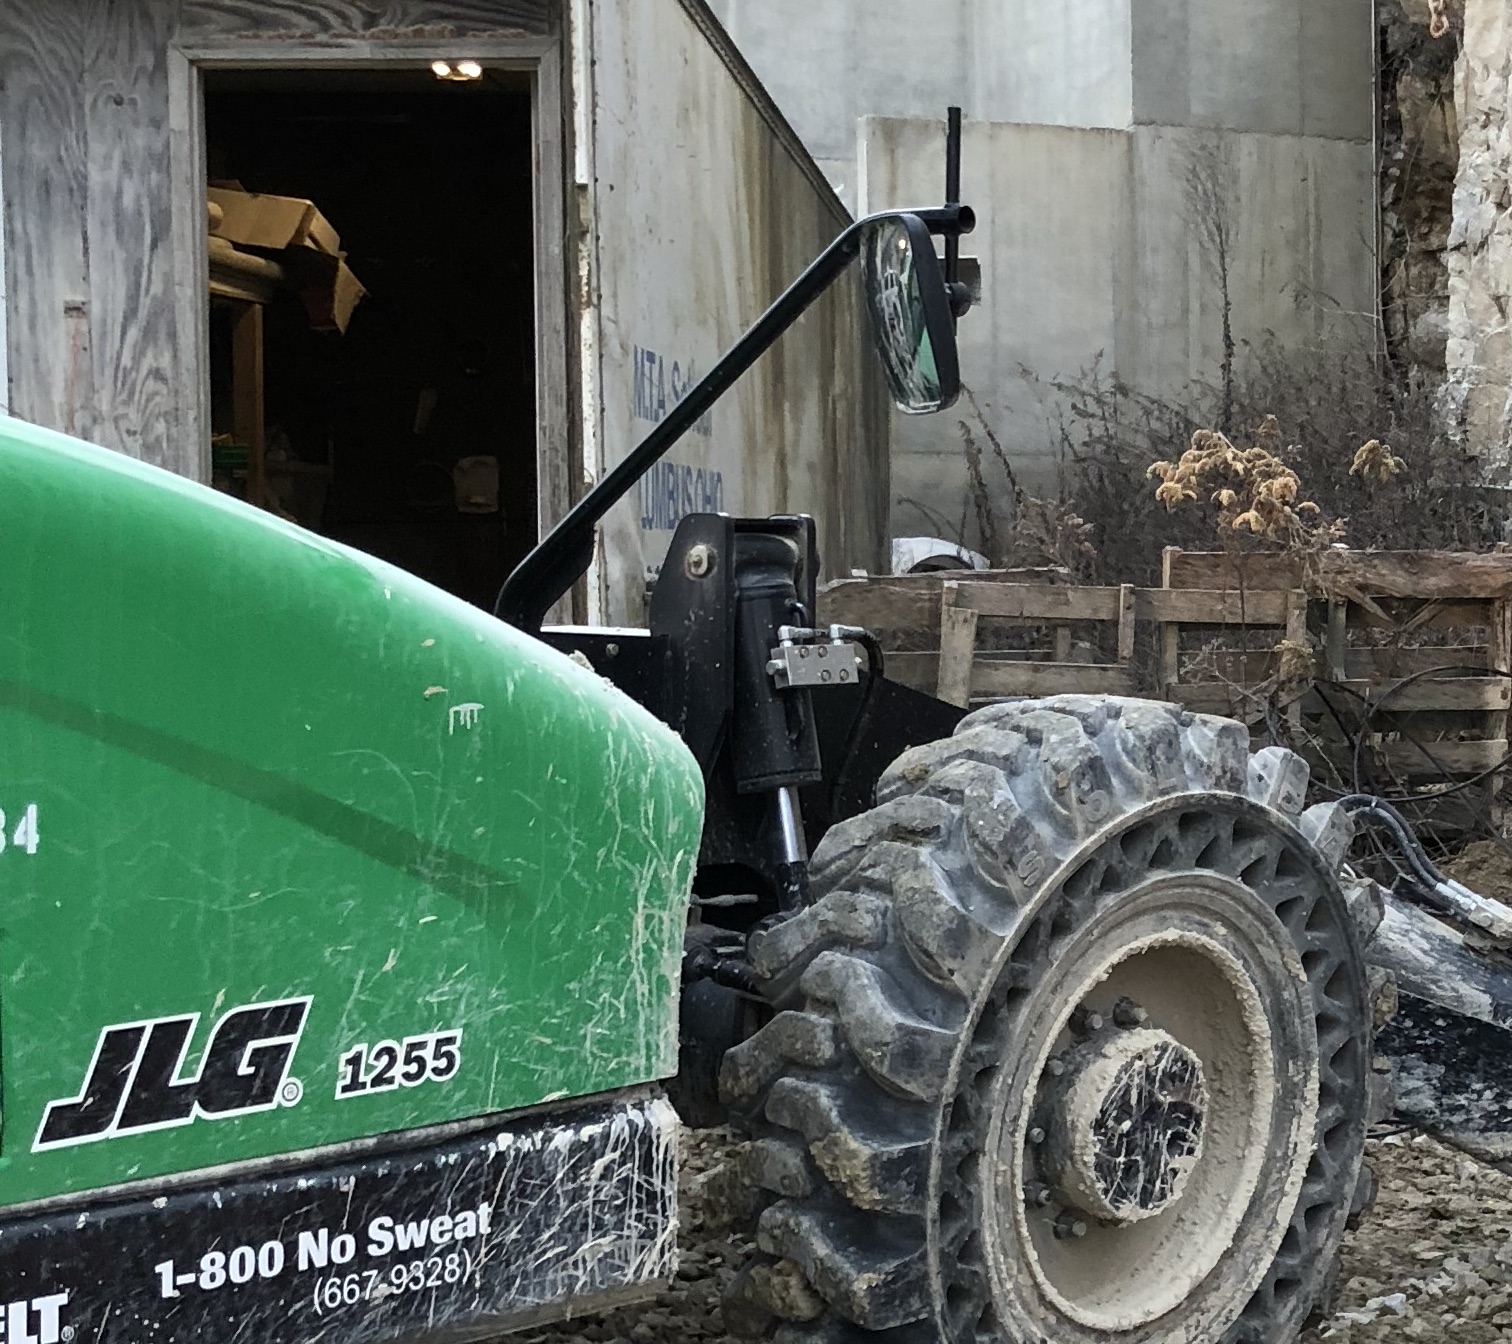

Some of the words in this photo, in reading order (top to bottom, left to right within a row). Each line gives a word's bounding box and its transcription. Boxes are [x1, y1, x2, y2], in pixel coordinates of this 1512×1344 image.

[30, 994, 315, 1153] JLG
[334, 1028, 463, 1100] 1255
[154, 1239, 285, 1299] 1-800
[297, 1227, 356, 1272] No
[367, 1200, 493, 1257] Sweat
[312, 1247, 473, 1317] (667-9328)
